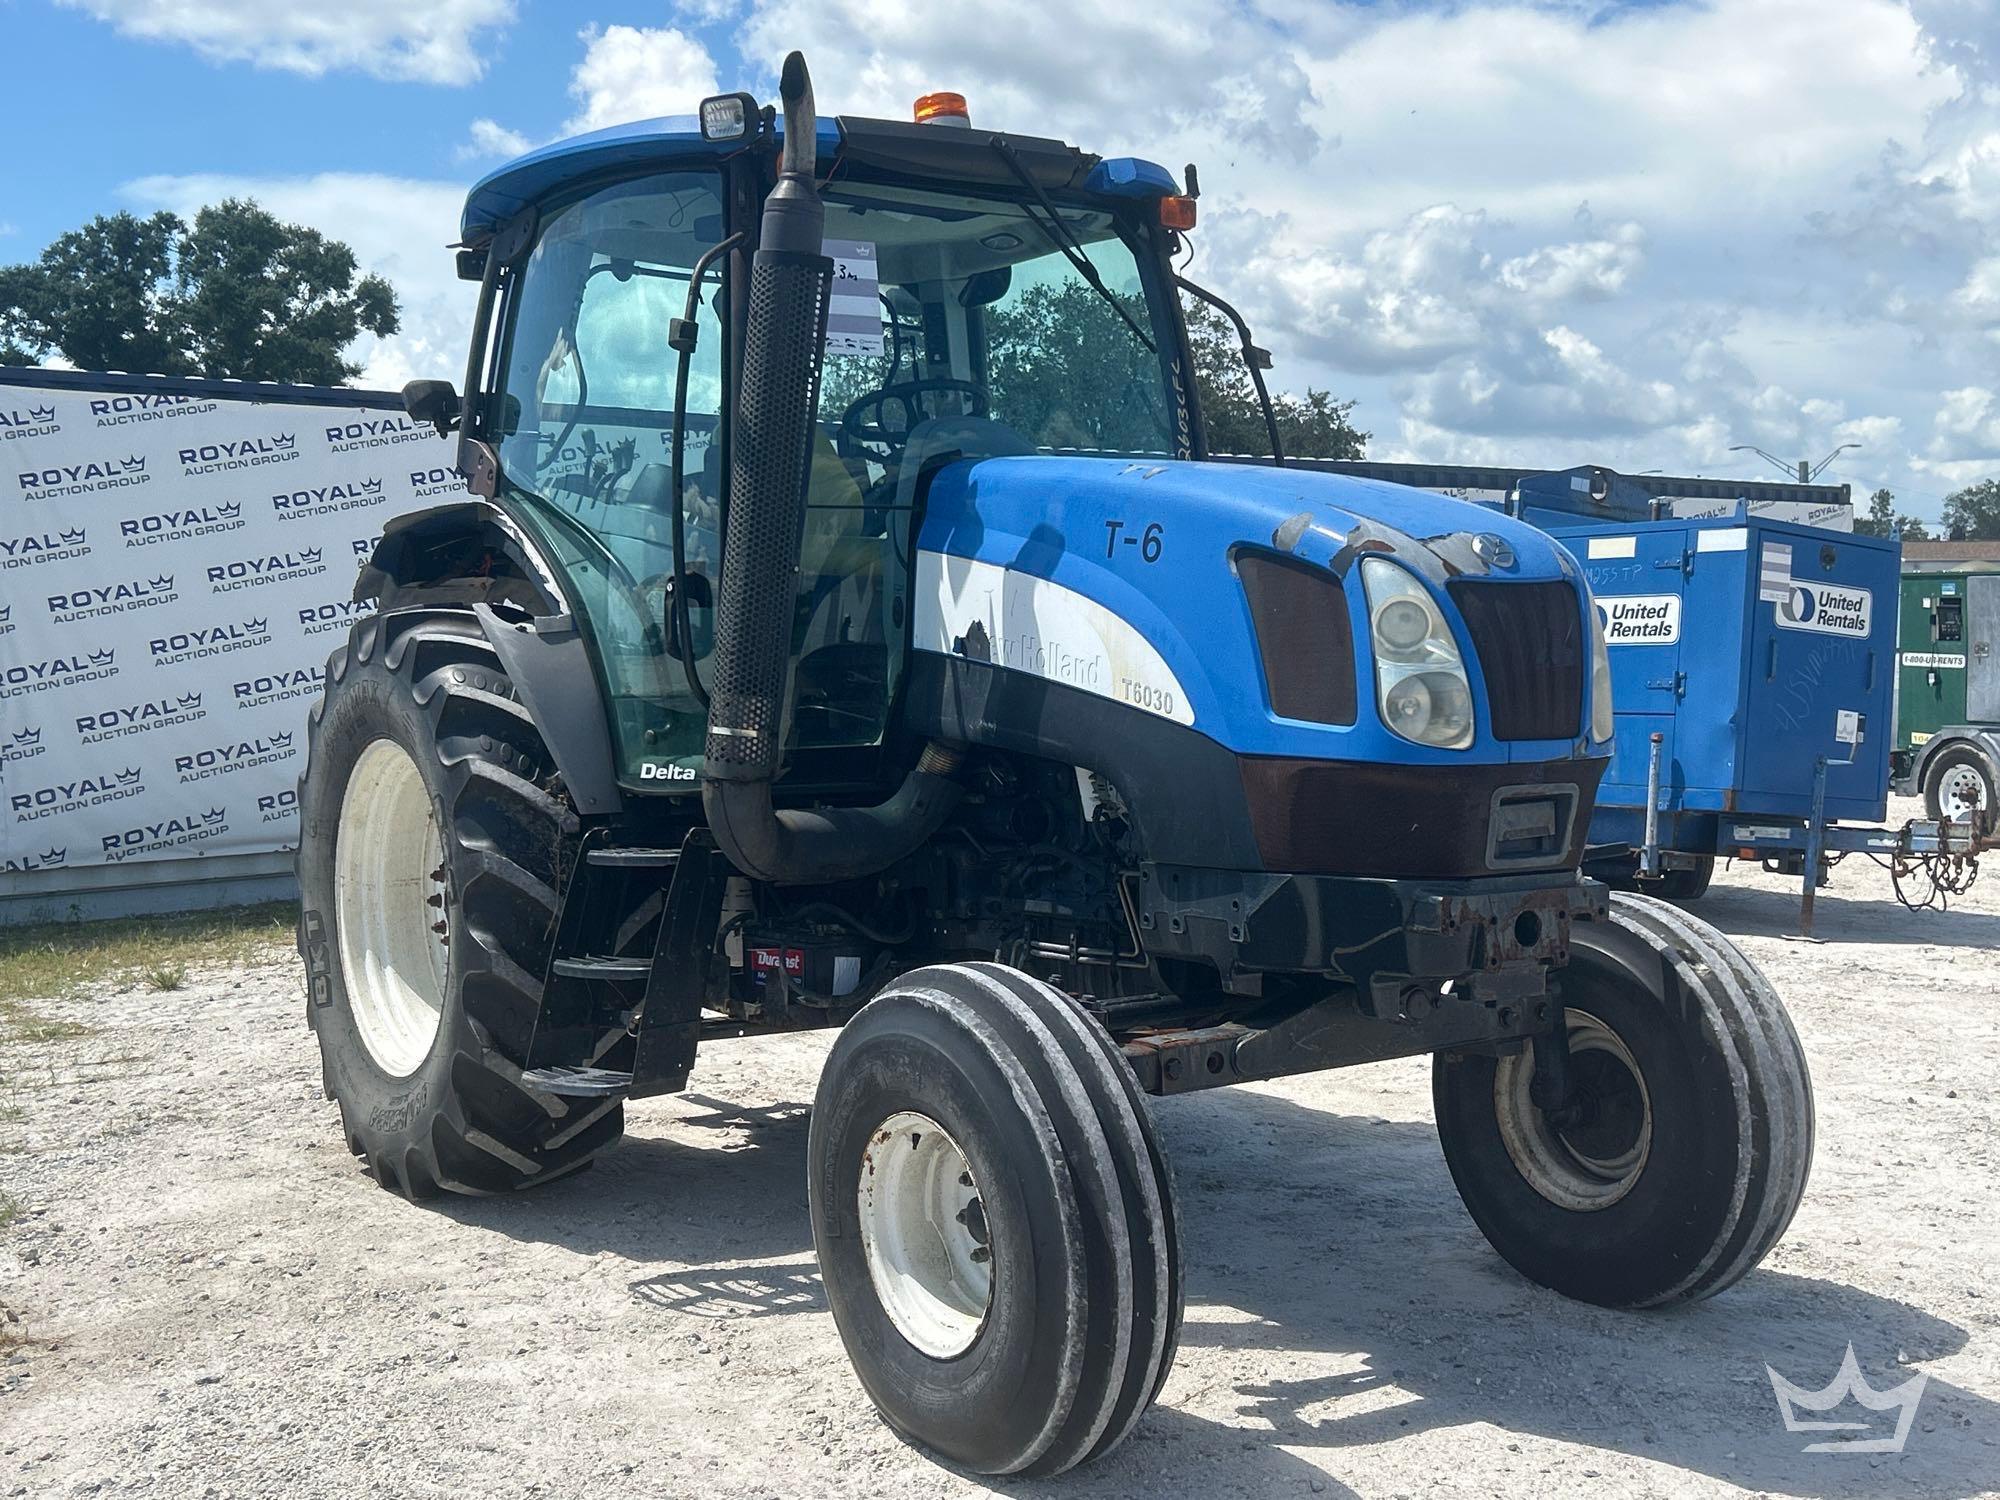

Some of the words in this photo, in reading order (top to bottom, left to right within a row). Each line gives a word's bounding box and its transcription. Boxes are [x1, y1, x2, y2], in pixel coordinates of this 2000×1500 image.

[96, 410, 164, 428] AUCTION
[166, 403, 218, 418] GROUP
[326, 417, 412, 442] ROYAL
[5, 424, 61, 440] GROUP
[331, 437, 389, 453] AUCTION
[391, 430, 437, 444] GROUP
[179, 438, 273, 465] ROYAL
[184, 459, 249, 476] AUCTION
[251, 451, 300, 466] GROUP
[18, 461, 121, 489] ROYAL
[25, 483, 95, 501] AUCTION
[97, 474, 151, 490] GROUP
[272, 483, 362, 510] ROYAL
[278, 503, 339, 522] AUCTION
[341, 495, 387, 511] GROUP
[120, 507, 217, 536] ROYAL
[1808, 505, 1838, 520] ROYAL
[0, 534, 61, 556] YAL
[126, 529, 192, 548] AUCTION
[195, 519, 246, 537] GROUP
[1105, 519, 1165, 564] T-6
[35, 546, 92, 564] GROUP
[207, 553, 301, 582] ROYAL
[212, 575, 276, 594] AUCTION
[278, 565, 327, 581] GROUP
[48, 581, 150, 612] ROYAL
[53, 603, 124, 624] AUCTION
[127, 593, 179, 610] GROUP
[1612, 602, 1669, 620] United
[1819, 591, 1864, 612] United
[1610, 621, 1673, 638] Rentals
[1817, 609, 1866, 631] Rentals
[149, 624, 244, 656] ROYAL
[155, 646, 219, 667] AUCTION
[222, 635, 273, 653] GROUP
[0, 656, 89, 688] OYAL
[1020, 633, 1102, 686] Holland
[0, 678, 61, 700] UCTION
[64, 667, 120, 687] GROUP
[233, 666, 325, 698] ROYAL
[1121, 678, 1174, 715] T6030
[238, 688, 301, 710] AUCTION
[76, 700, 178, 733] ROYAL
[82, 723, 150, 745] AUCTION
[153, 709, 207, 729] GROUP
[1, 746, 46, 762] ROUP
[175, 739, 271, 773] ROYAL
[179, 761, 245, 784] AUCTION
[248, 749, 297, 767] GROUP
[640, 763, 696, 781] Delta
[11, 776, 116, 812] ROYAL
[17, 799, 88, 824] AUCTION
[91, 785, 146, 806] GROUP
[101, 815, 202, 852] ROYAL
[105, 839, 174, 862] AUCTION
[177, 824, 230, 845] GROUP
[305, 911, 330, 1006] BKT
